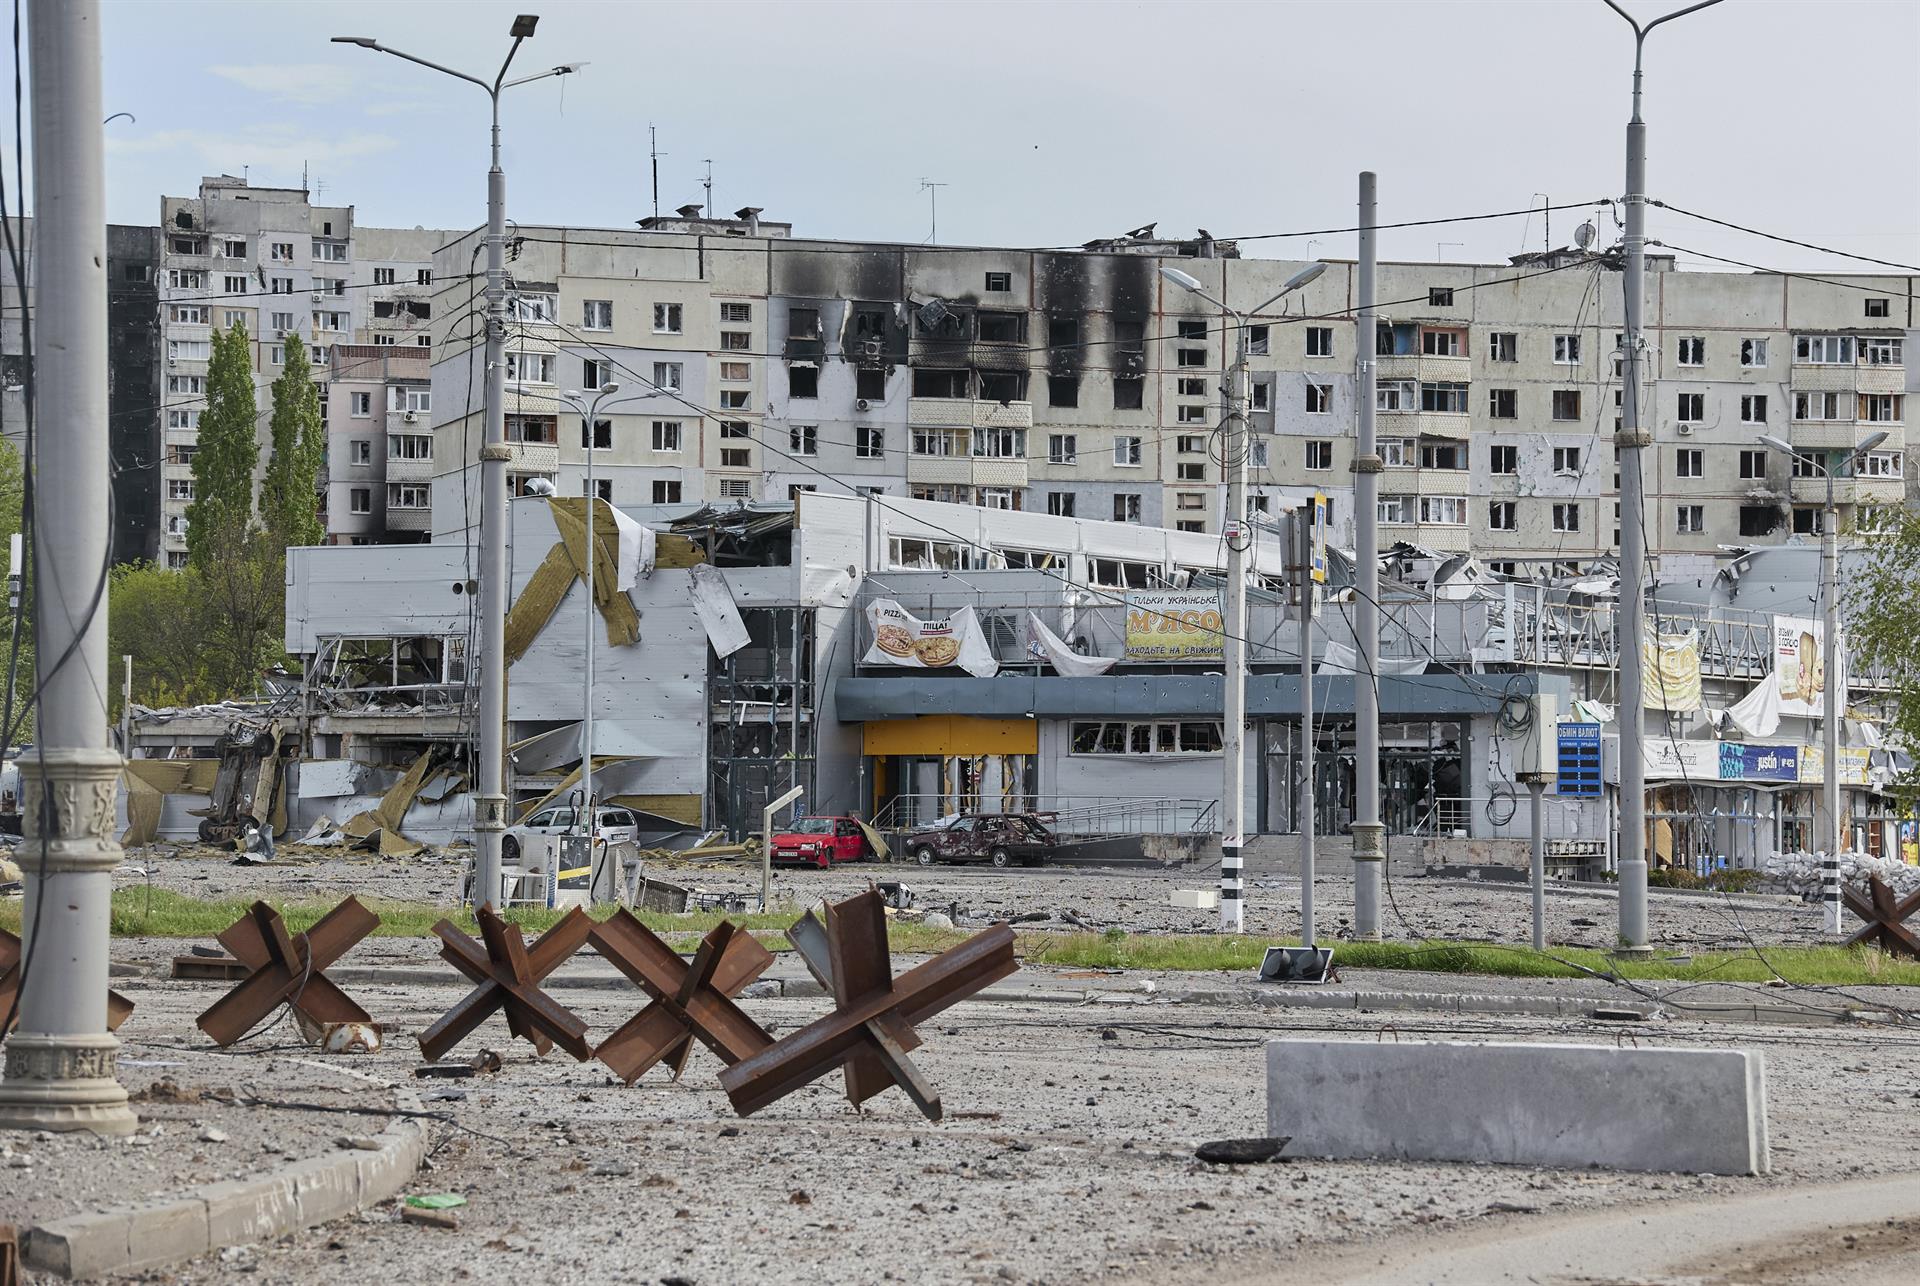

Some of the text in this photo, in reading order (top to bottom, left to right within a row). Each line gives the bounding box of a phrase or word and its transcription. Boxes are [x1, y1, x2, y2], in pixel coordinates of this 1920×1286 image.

[1133, 594, 1218, 605] ТІЛЬКИ УКРАЇНСЬКЕ
[923, 623, 948, 631] ПІЦА!
[1169, 646, 1180, 654] НА
[1559, 727, 1598, 738] ОБМІН ВАЛЮТ
